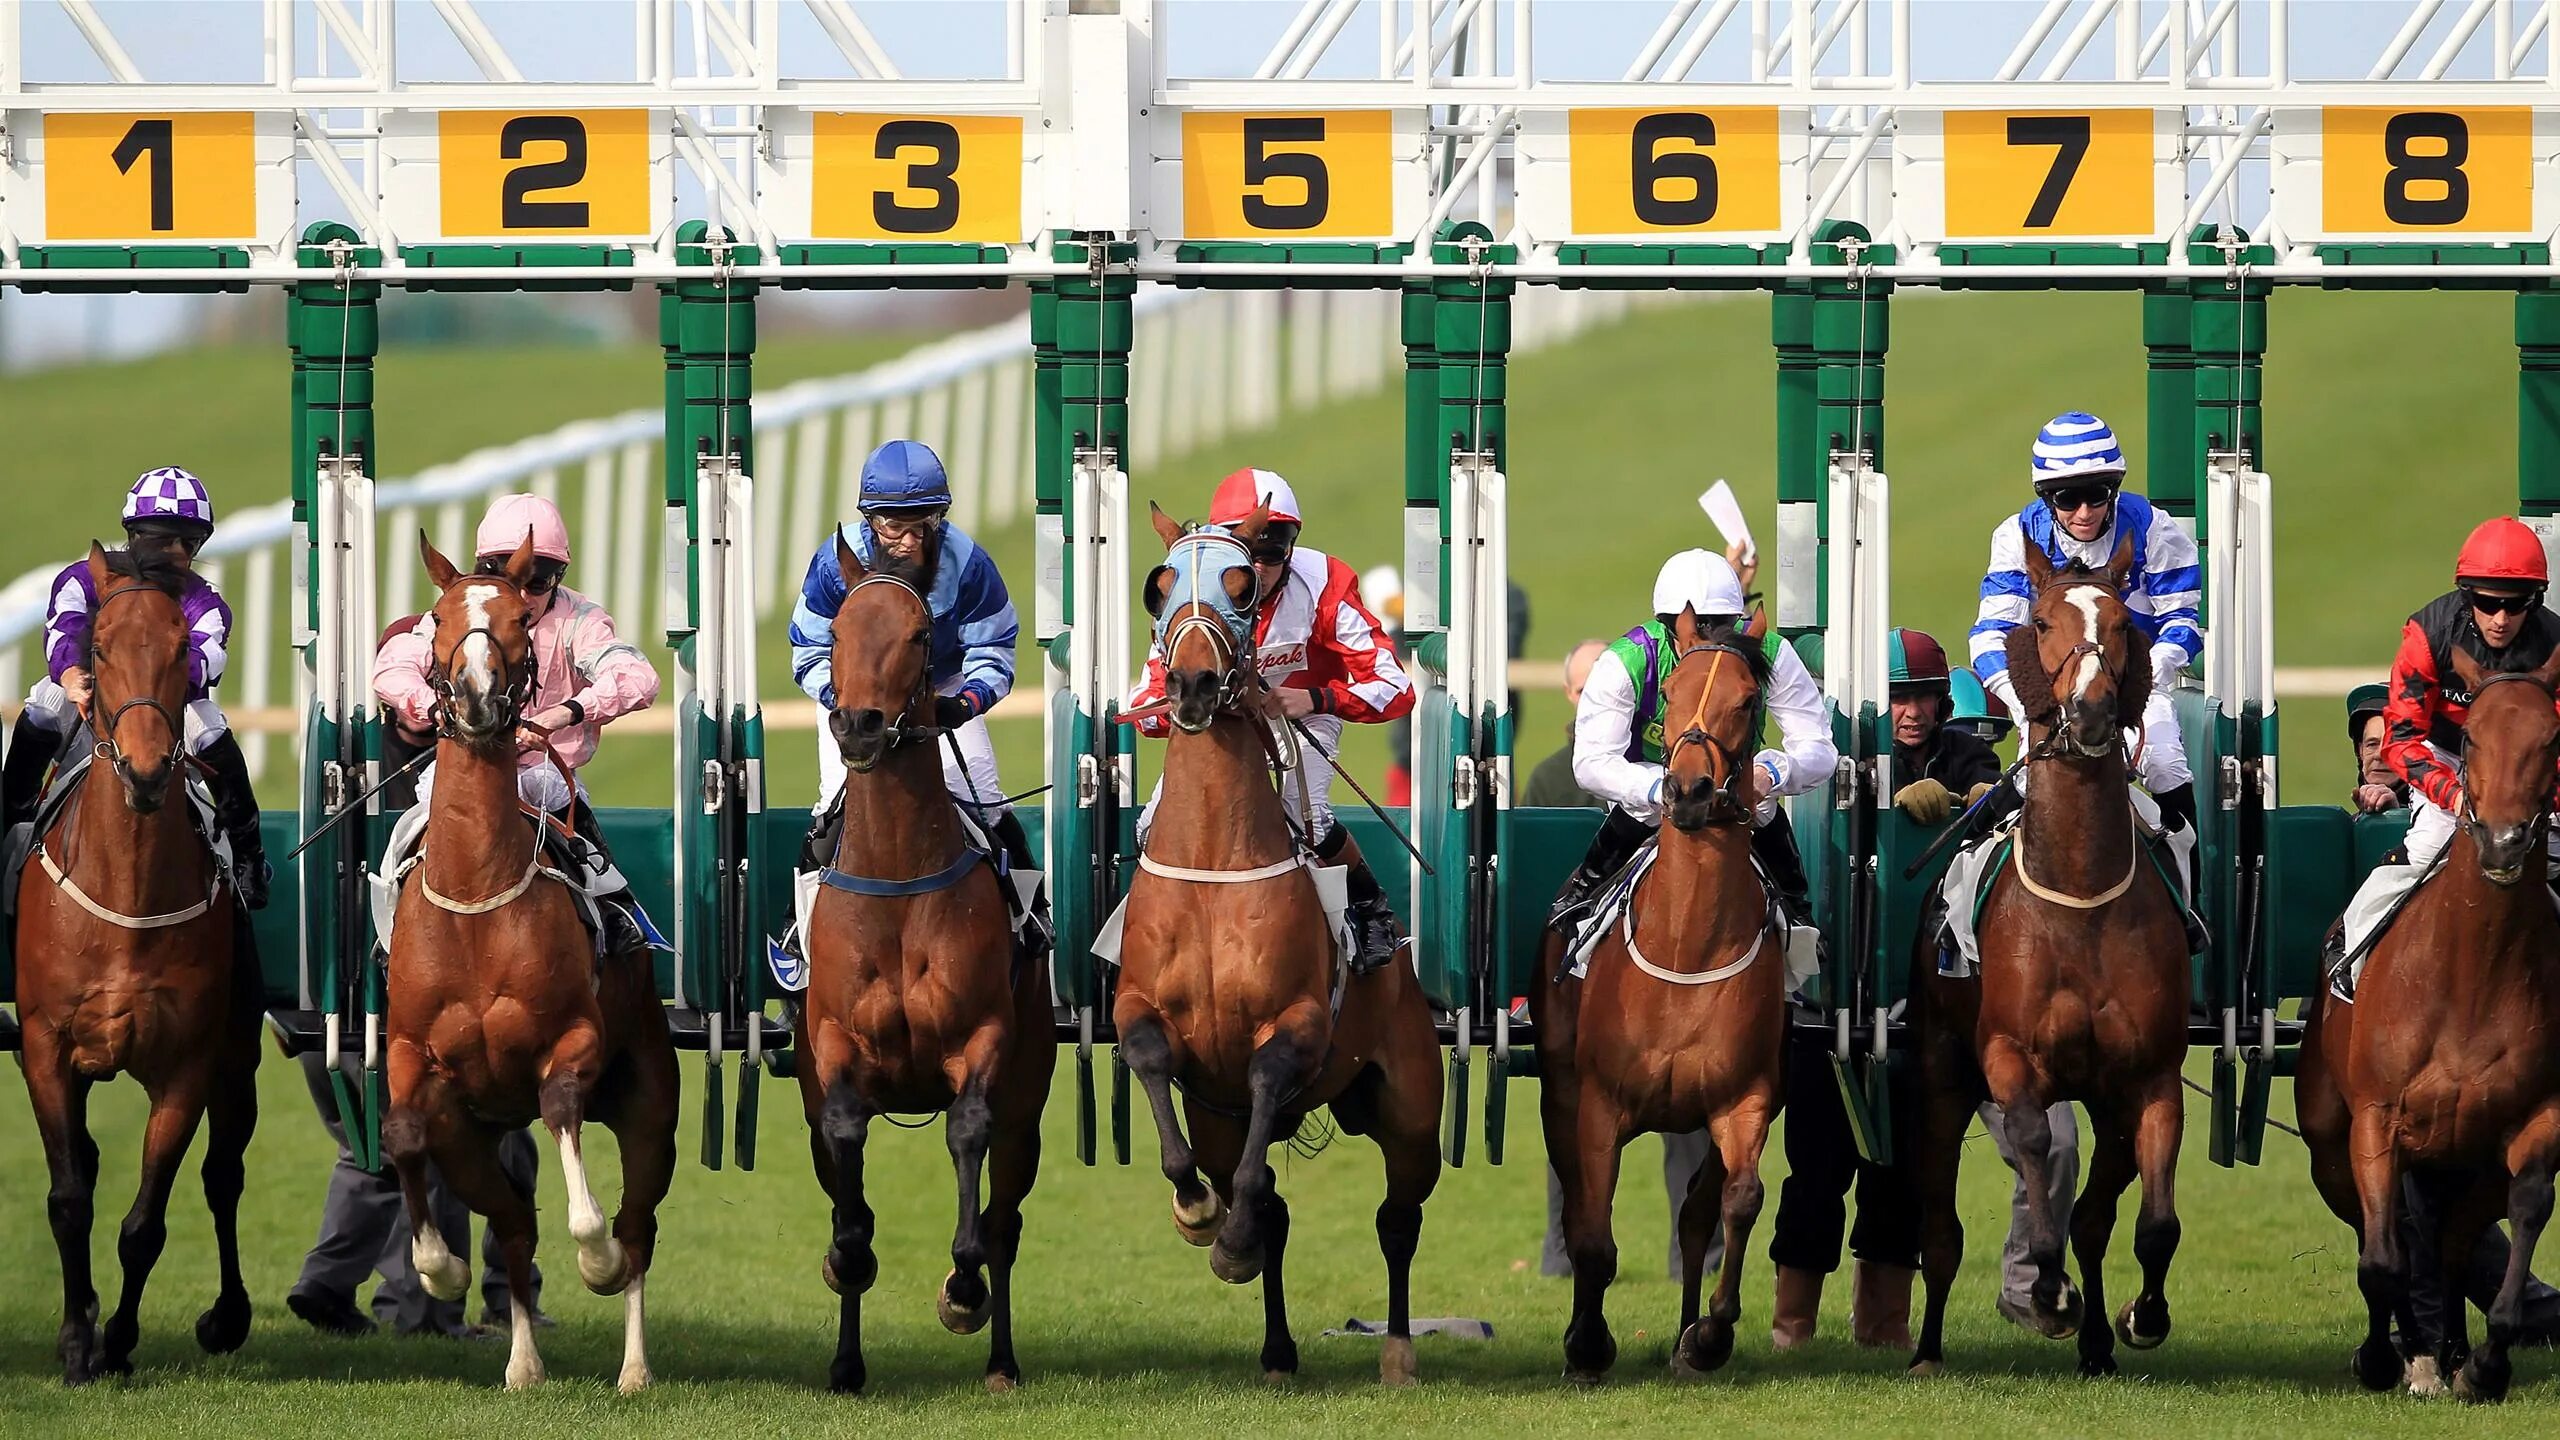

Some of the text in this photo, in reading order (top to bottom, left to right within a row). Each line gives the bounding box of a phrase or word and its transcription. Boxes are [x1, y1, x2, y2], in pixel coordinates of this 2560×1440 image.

[112, 120, 173, 230] 1
[501, 116, 589, 228] 2
[873, 121, 959, 233] 3
[1242, 118, 1328, 229] 5
[1632, 113, 1718, 225] 6
[2007, 117, 2090, 227] 7
[2384, 112, 2469, 225] 8
[1257, 644, 1303, 675] epak
